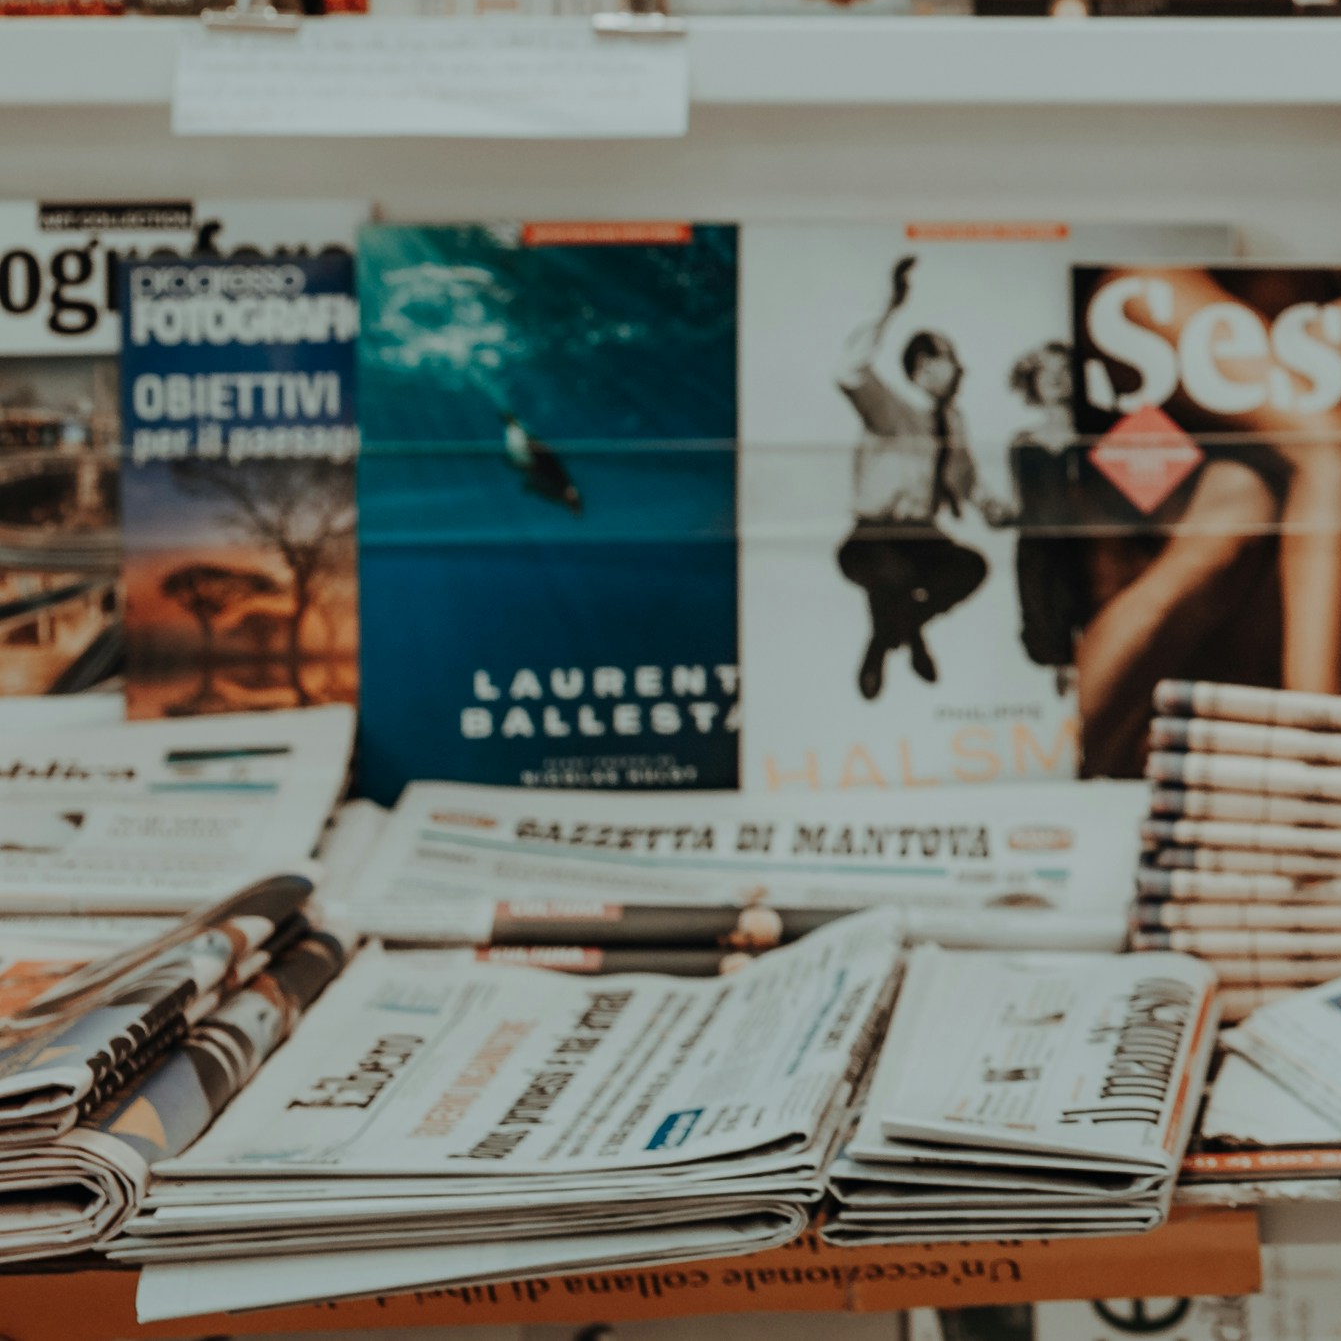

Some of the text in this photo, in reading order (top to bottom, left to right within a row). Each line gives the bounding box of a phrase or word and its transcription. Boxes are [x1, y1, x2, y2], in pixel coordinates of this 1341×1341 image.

[131, 264, 306, 302] progresso
[134, 372, 341, 421] OBIETTIVI
[513, 816, 993, 860] GAZZETTA DI MANTOVA
[510, 1279, 551, 1304] di
[565, 1268, 710, 1300] collana
[722, 1256, 1023, 1293] Un'eccezionale
